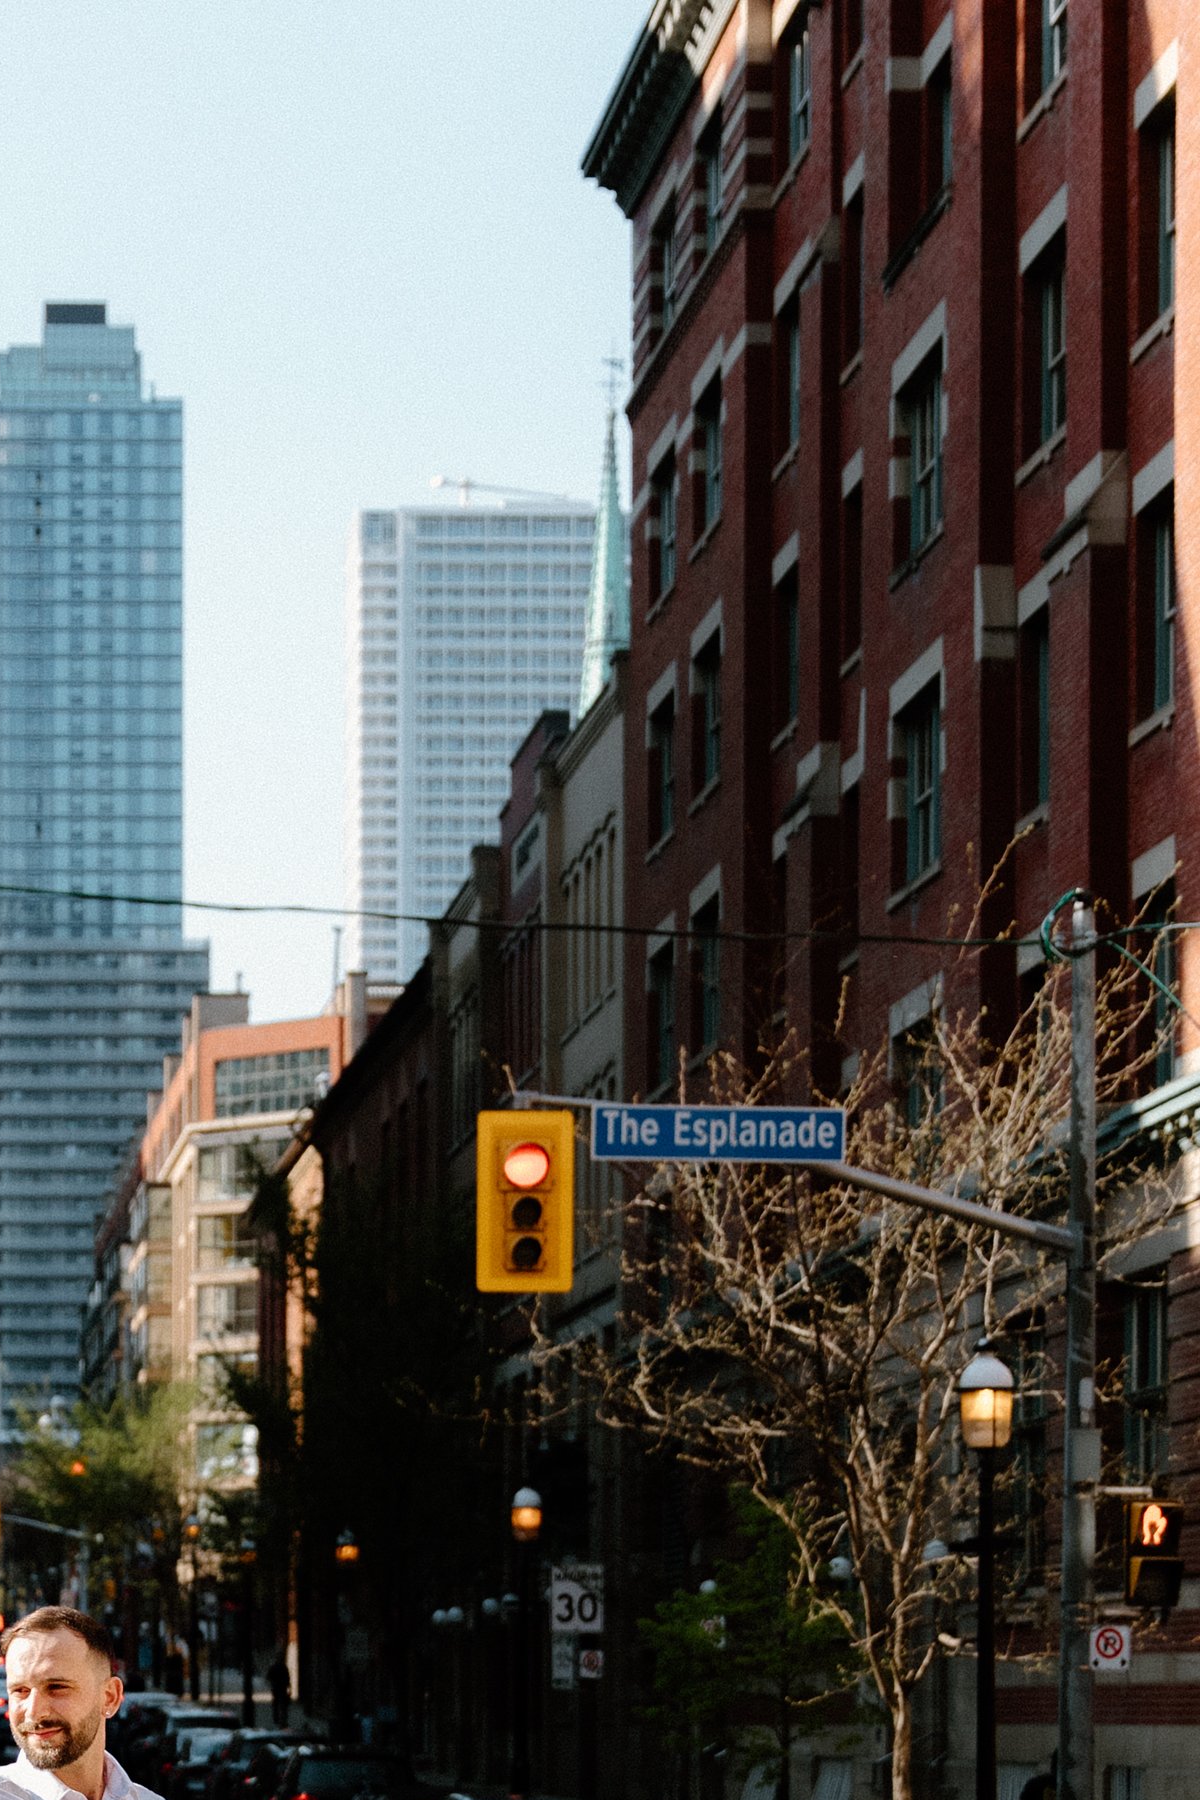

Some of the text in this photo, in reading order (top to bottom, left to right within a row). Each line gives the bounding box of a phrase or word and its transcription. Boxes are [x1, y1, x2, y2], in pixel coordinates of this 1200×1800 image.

[602, 1110, 837, 1155] The Esplanade
[556, 1592, 598, 1623] 30
